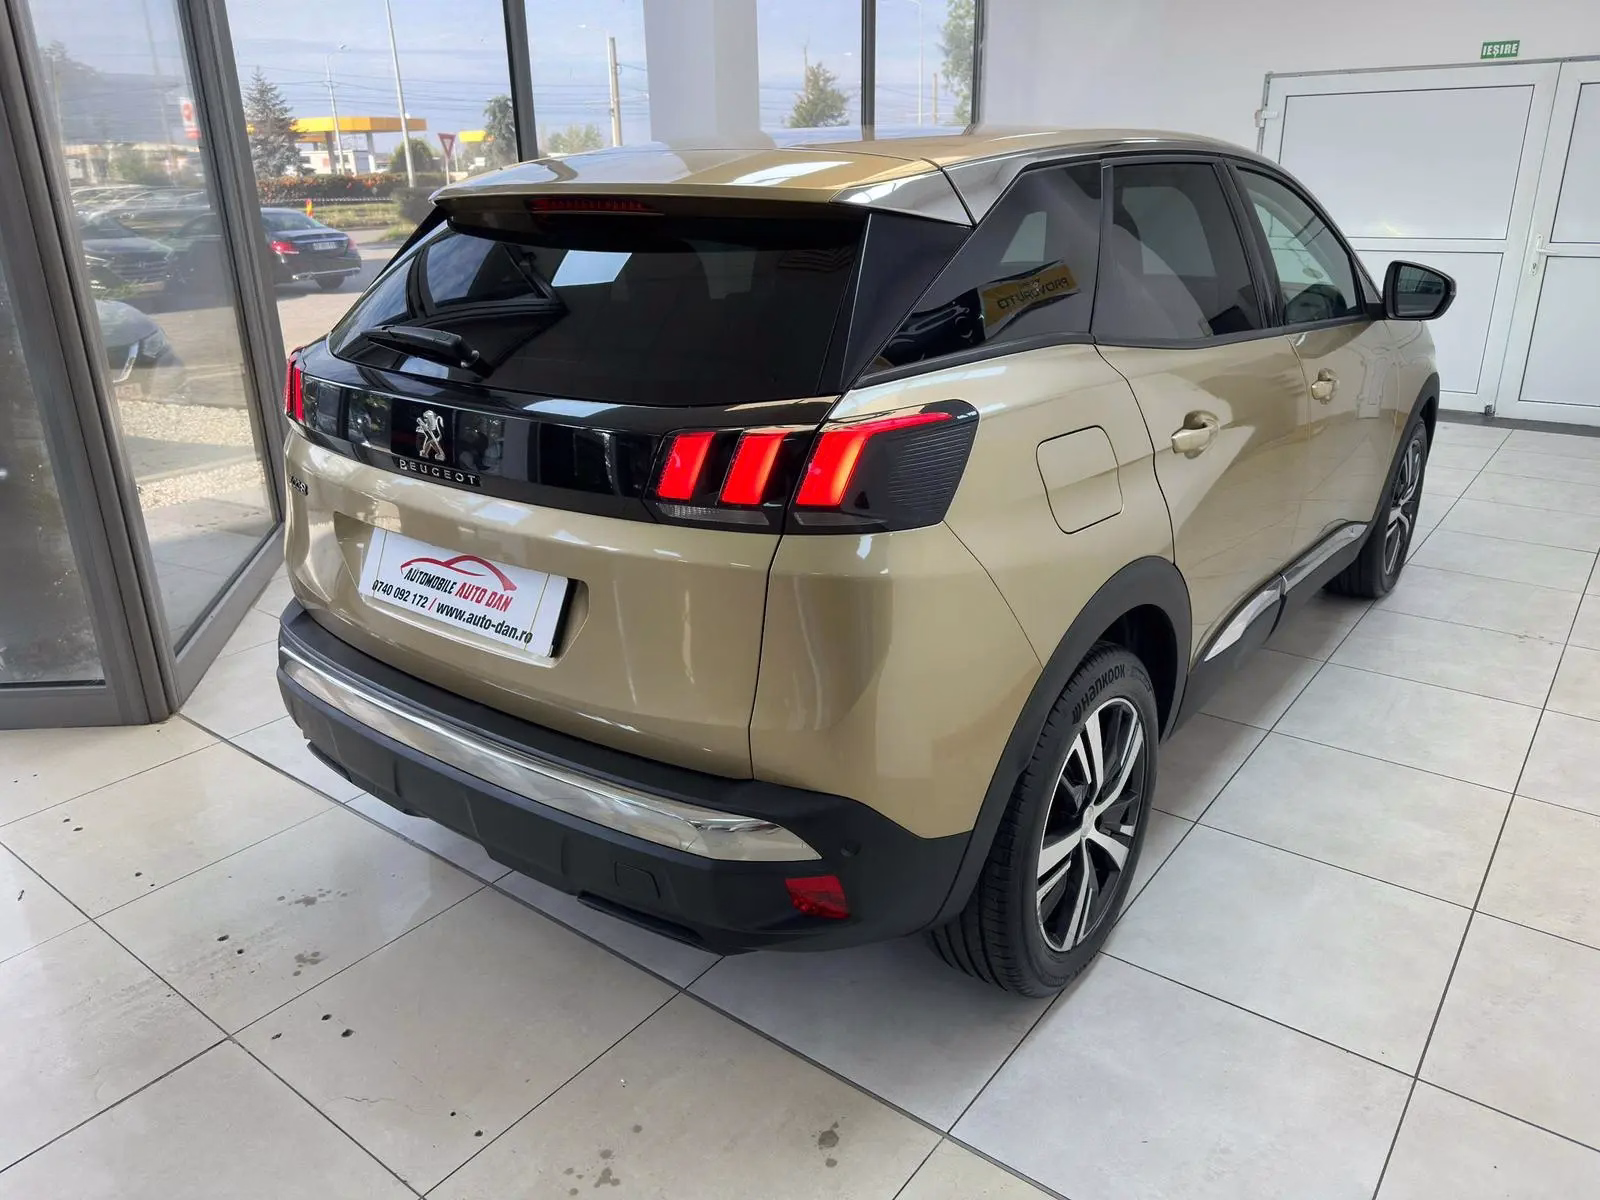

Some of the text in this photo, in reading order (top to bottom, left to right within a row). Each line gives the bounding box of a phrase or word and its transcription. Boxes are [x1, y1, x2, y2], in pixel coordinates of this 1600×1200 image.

[399, 459, 476, 485] PEUGEOT
[372, 579, 394, 596] 0740
[393, 587, 411, 602] 092
[411, 593, 429, 609] 172
[435, 602, 533, 644] www.auto-dan.ro
[404, 567, 513, 613] AUTOMOBILE AUTO DAN
